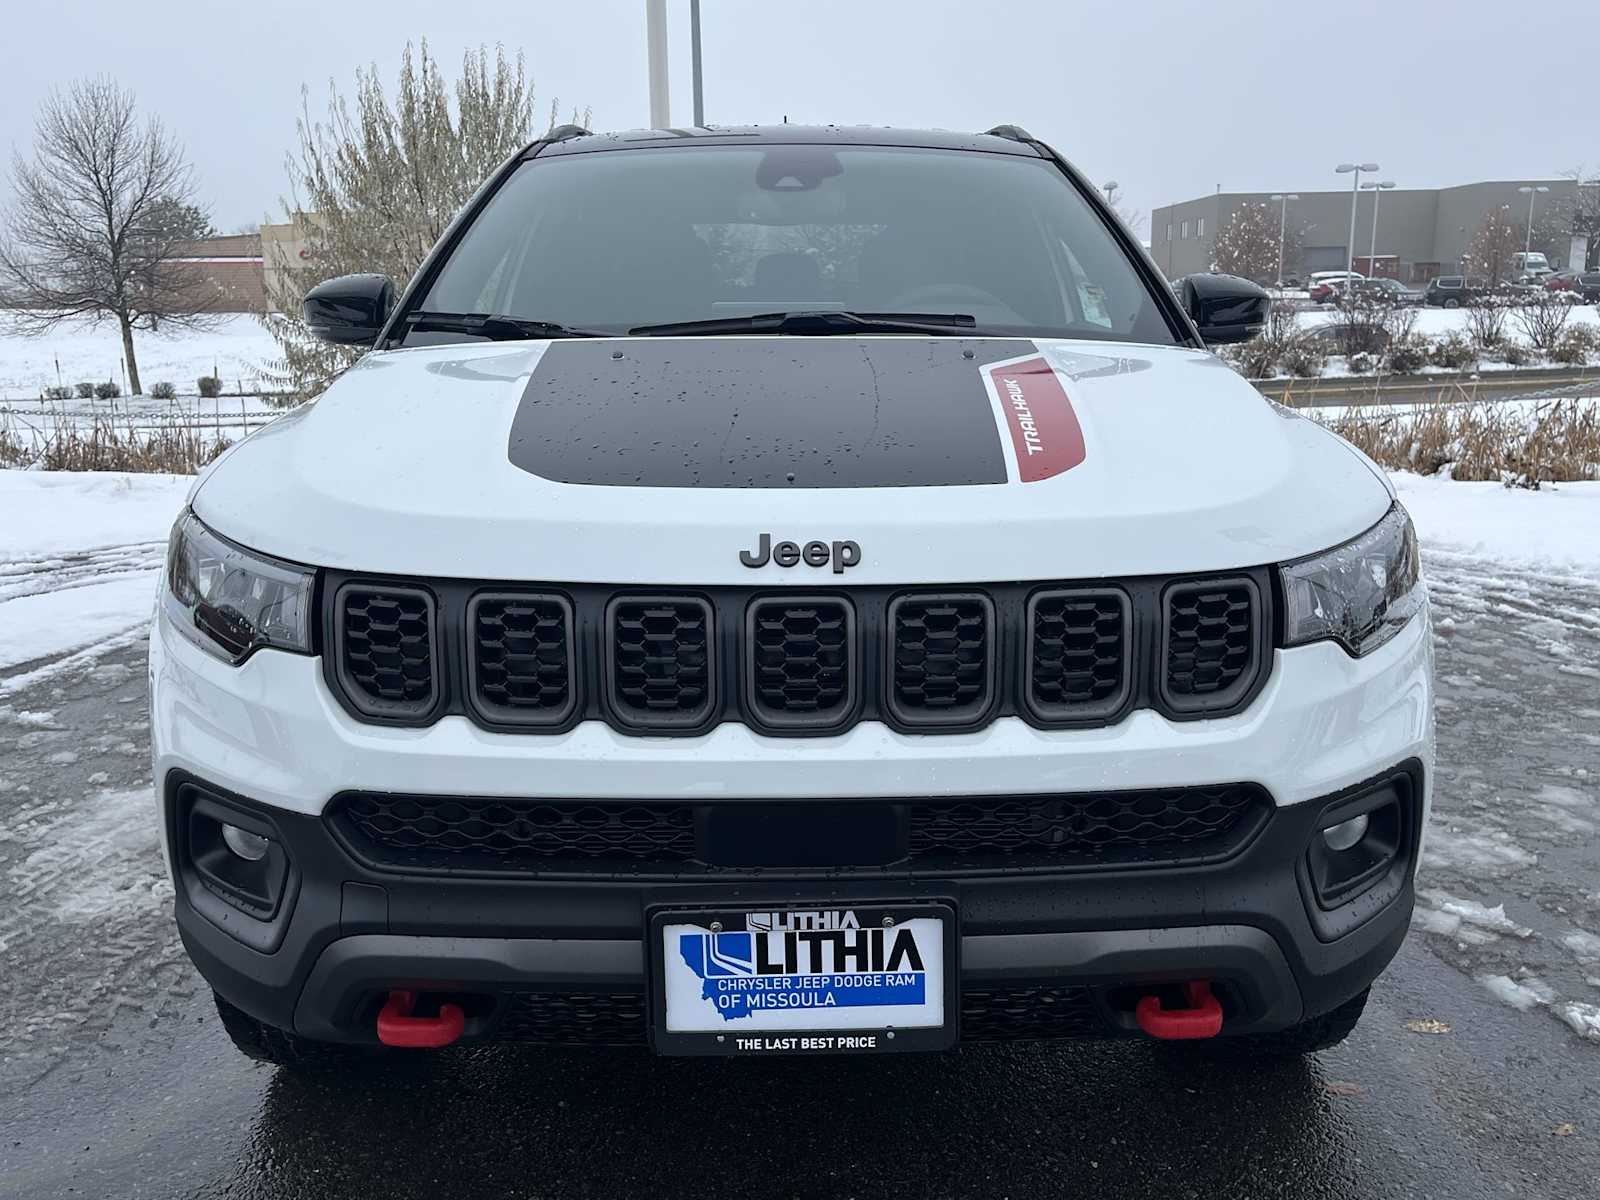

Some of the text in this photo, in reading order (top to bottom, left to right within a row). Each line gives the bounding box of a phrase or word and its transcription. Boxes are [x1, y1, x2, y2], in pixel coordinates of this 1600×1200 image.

[1003, 379, 1043, 456] TRAILHAWK
[740, 533, 861, 574] Jeep
[771, 910, 860, 930] LITHIA
[755, 929, 925, 974] LITHIA
[717, 974, 916, 991] CHRYSLER JEEP DODGE RAM
[718, 992, 836, 1008] OF MISSOULA
[736, 1036, 876, 1049] THE LAST BEST PRICE
